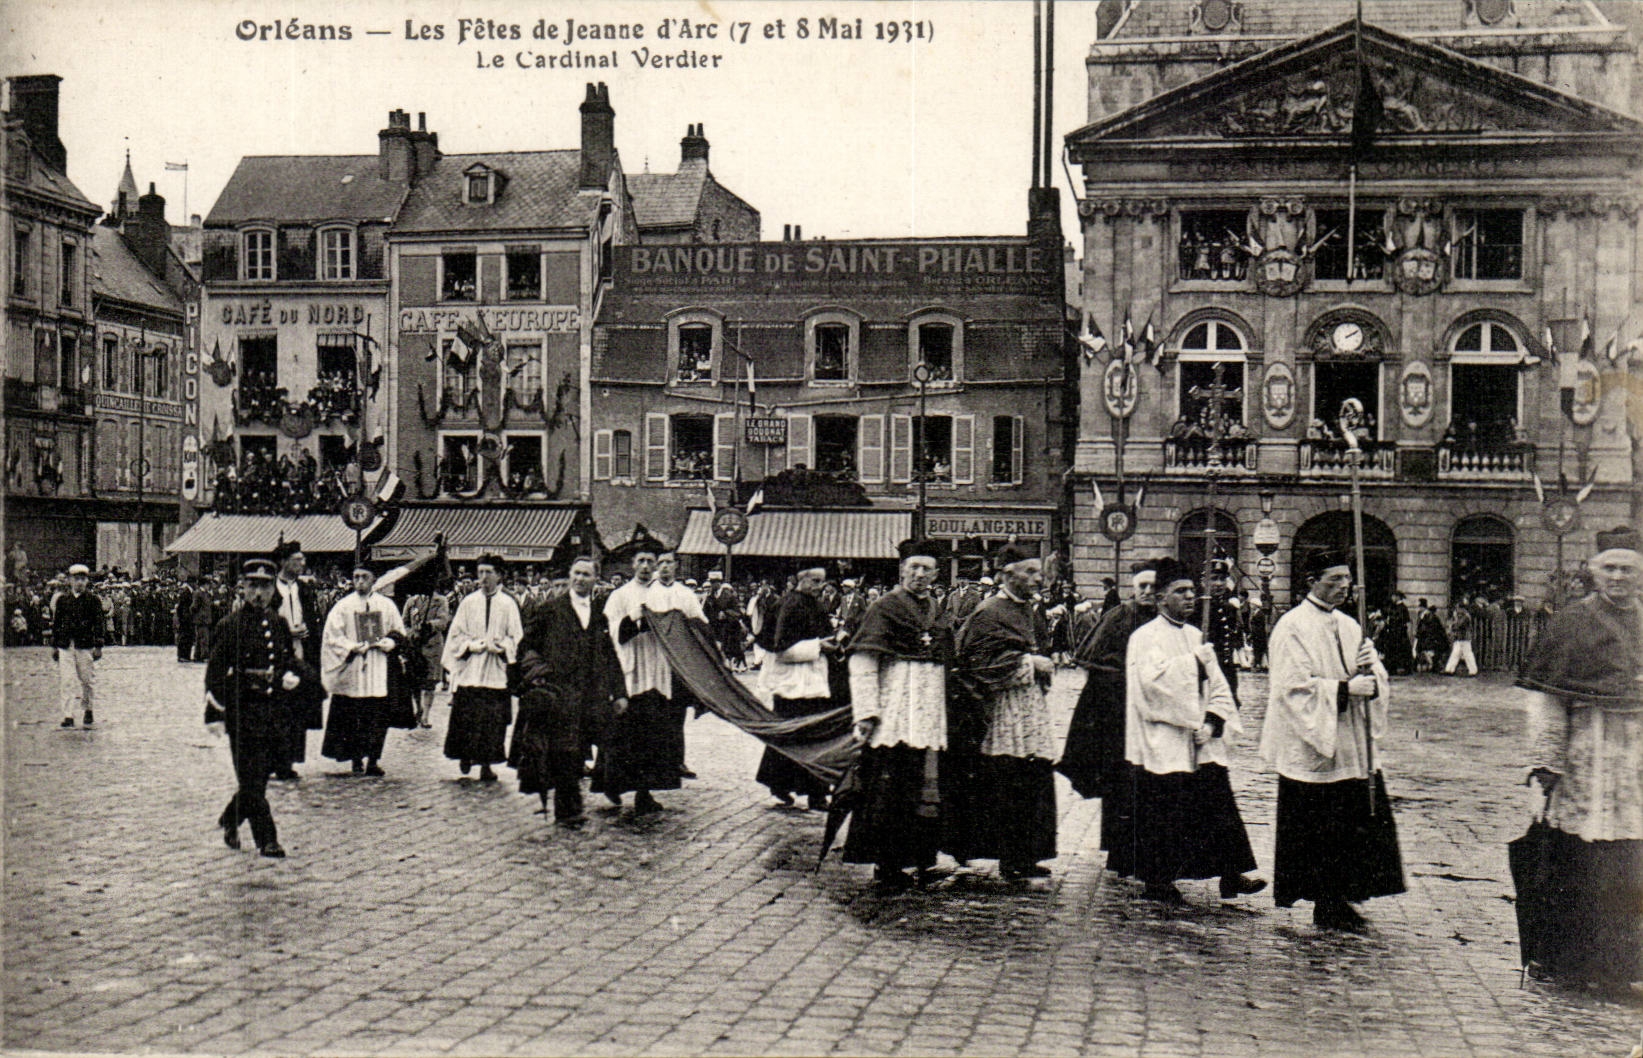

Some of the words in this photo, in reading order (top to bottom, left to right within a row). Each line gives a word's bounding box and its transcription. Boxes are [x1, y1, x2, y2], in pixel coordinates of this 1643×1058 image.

[631, 247, 755, 274] BANQUE
[765, 253, 796, 273] DE
[804, 246, 1047, 273] SAINT-PHALLE
[221, 298, 273, 325] CAFÉ
[280, 308, 299, 325] DU
[307, 303, 365, 325] NORD
[185, 302, 199, 426] PICON
[928, 519, 1046, 535] BOULANGERIE
